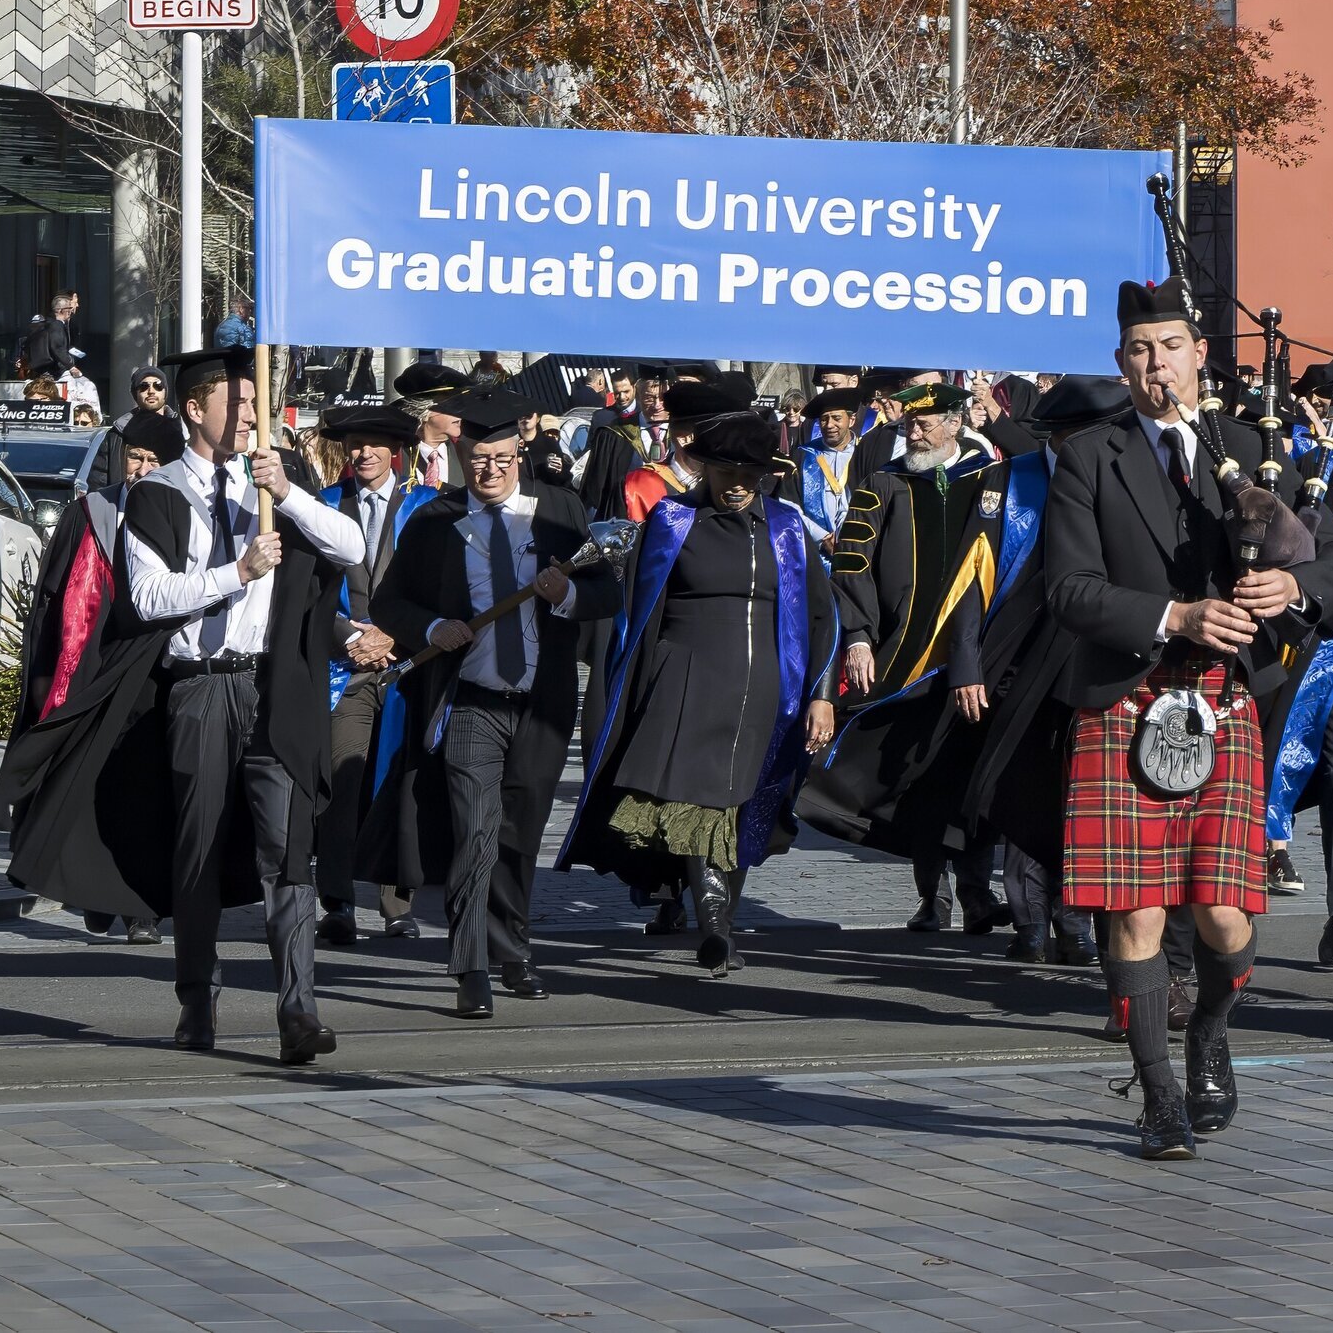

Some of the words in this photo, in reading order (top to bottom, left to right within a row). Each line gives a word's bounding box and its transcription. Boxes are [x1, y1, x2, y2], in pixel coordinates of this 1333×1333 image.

[143, 0, 241, 19] BEGINS
[419, 168, 651, 227] Lincoln
[675, 179, 1002, 252] University
[327, 238, 698, 301] Graduation
[718, 253, 1088, 317] Procession
[28, 410, 64, 421] CABS
